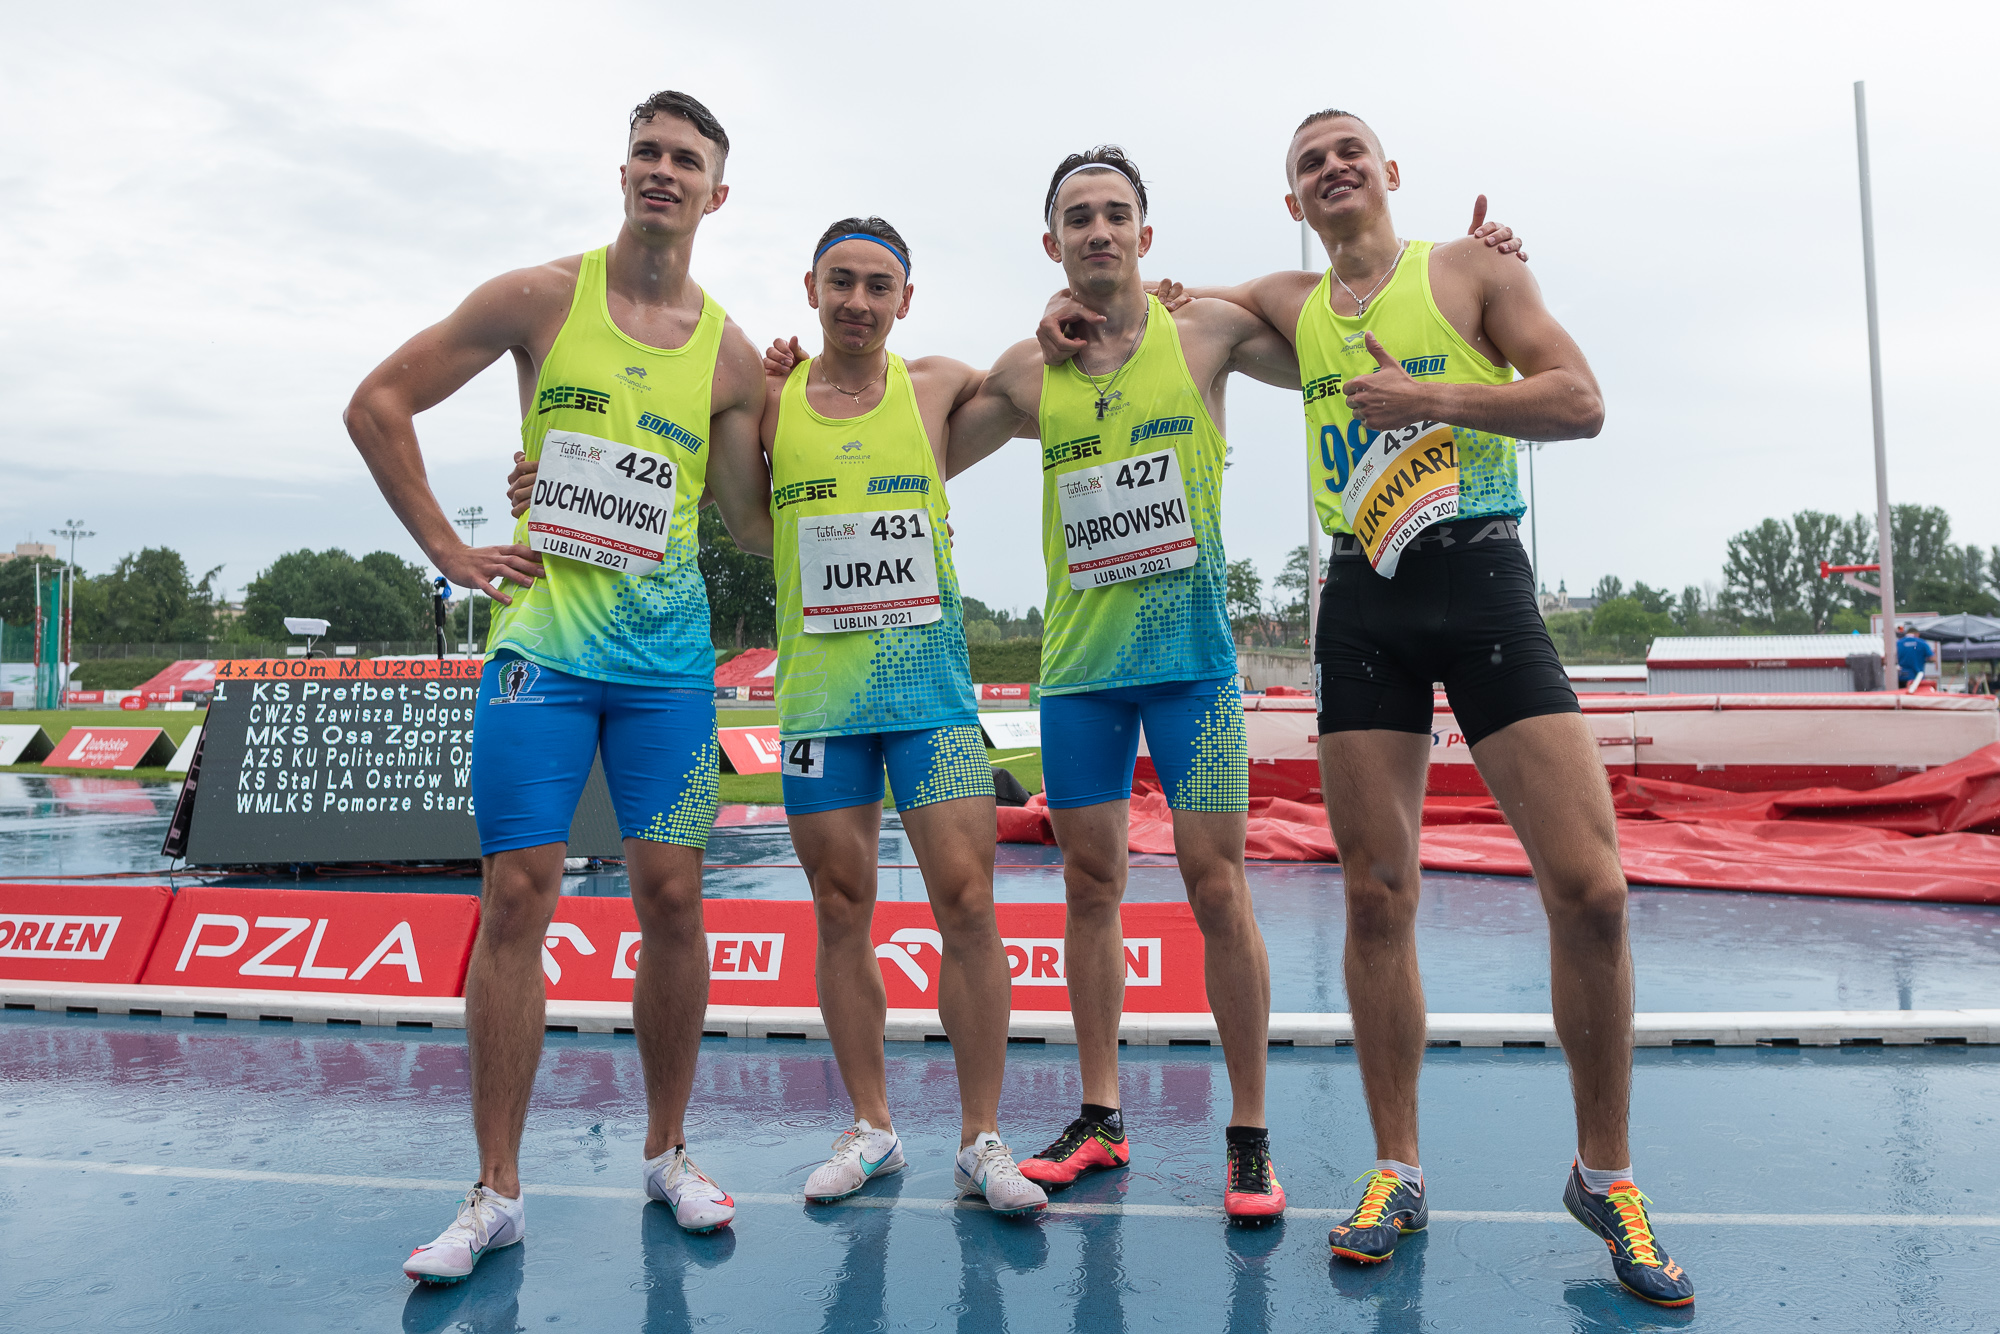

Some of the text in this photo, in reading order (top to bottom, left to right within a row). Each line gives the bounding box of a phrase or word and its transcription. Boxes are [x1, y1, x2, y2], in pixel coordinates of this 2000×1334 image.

[538, 386, 611, 415] PREFBET
[635, 411, 706, 456] SONAROL
[1130, 416, 1196, 446] SONAROL
[615, 452, 674, 490] 428
[866, 475, 932, 495] SONAROL
[1115, 455, 1170, 490] 427
[534, 479, 668, 535] DUCHNOWSKI
[1358, 441, 1459, 548] LIKWIARZ
[869, 513, 925, 541] 431
[1064, 498, 1186, 550] DĄBROWSKI
[1391, 493, 1438, 534] MISTRZOSTWA
[1391, 500, 1458, 553] LUBLIN 2021
[543, 537, 629, 570] LUBLIN 2021
[555, 528, 612, 547] MISTRZOSTWA
[613, 542, 641, 554] POLSKI
[642, 550, 659, 559] U20
[1098, 551, 1150, 567] MISTRZOSTWA
[1150, 544, 1176, 555] POLSKI
[1177, 540, 1192, 548] U20
[823, 557, 916, 591] JURAK
[1093, 557, 1172, 585] LUBLIN 2021
[833, 611, 913, 630] LUBLIN 2021
[840, 603, 893, 612] MISTRZOSTWA
[339, 660, 362, 677] M
[367, 660, 484, 678] U20-Bie
[213, 682, 228, 701] 1
[252, 682, 291, 701] KS
[249, 703, 474, 727] CWZS Zawisza Bydgos
[245, 725, 475, 750] MKS Osa Zgorze
[242, 747, 473, 771] AZS KU Politechniki Op
[788, 739, 815, 774] 4
[238, 769, 471, 791] KS Stal LA Ostrów W
[236, 792, 475, 816] WMLKS Pomorze Starg
[0, 921, 109, 954] ORLEN
[174, 913, 424, 983] PZLA
[1004, 945, 1150, 979] ORN
